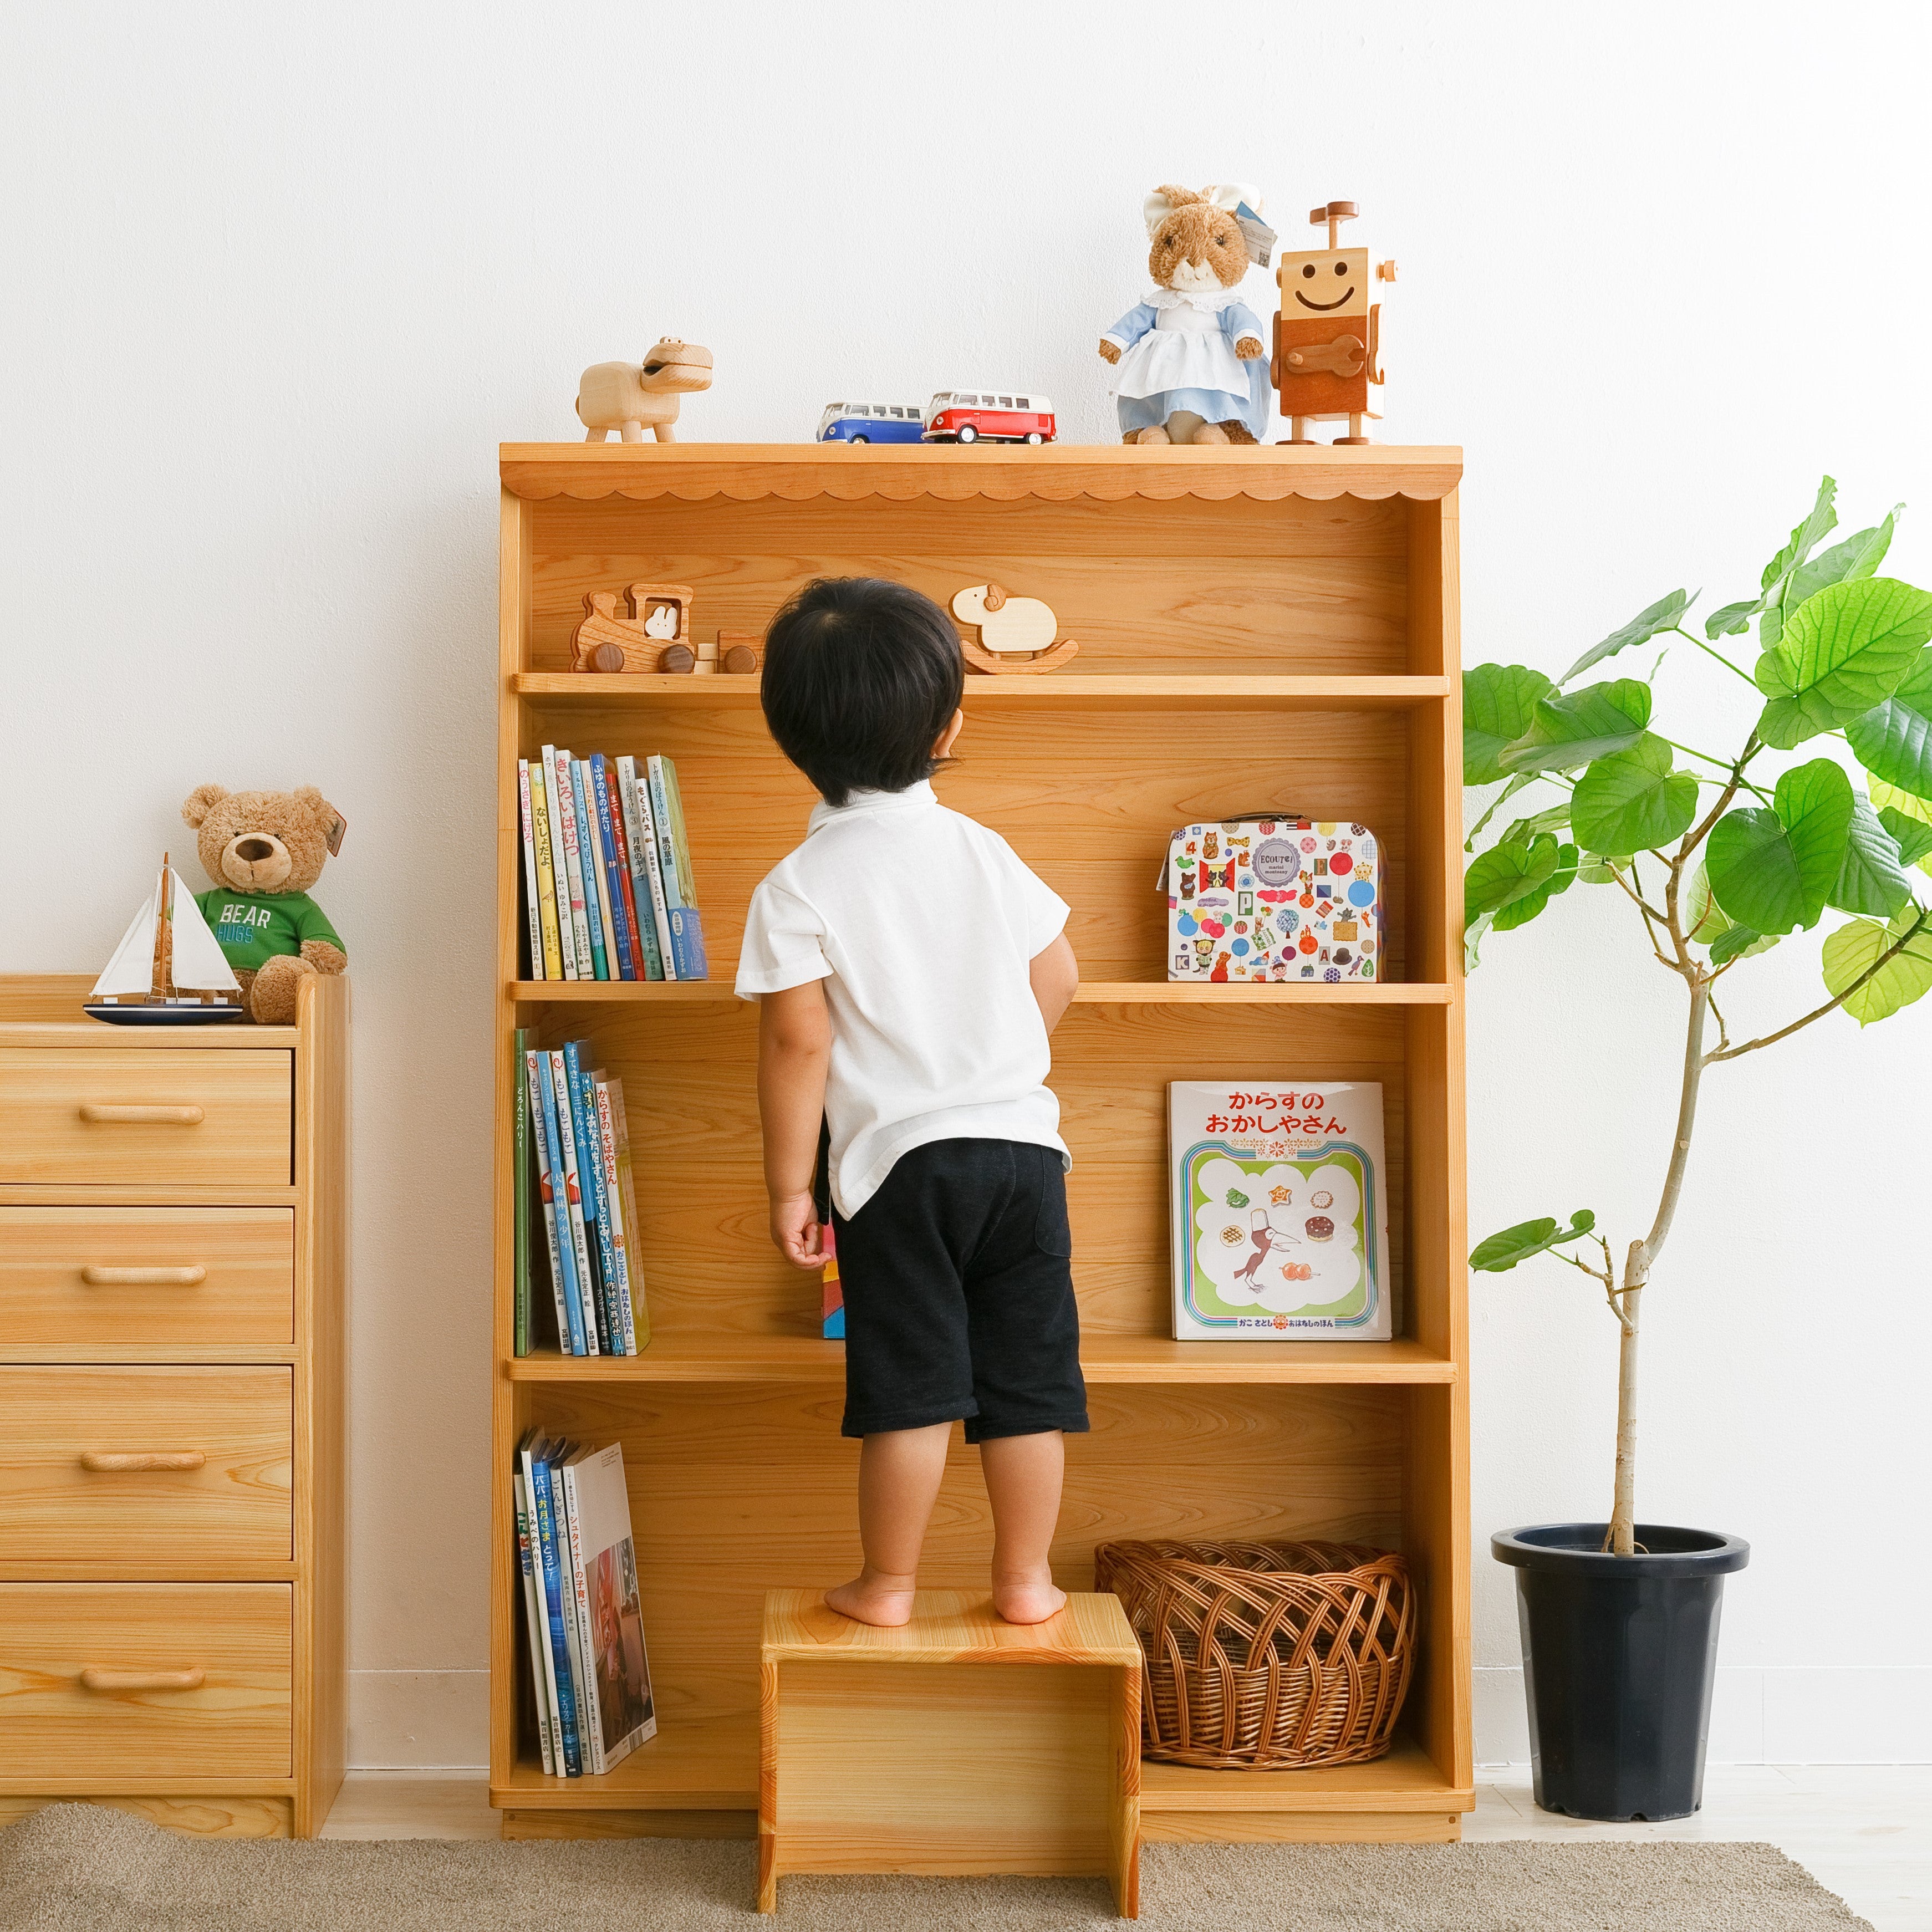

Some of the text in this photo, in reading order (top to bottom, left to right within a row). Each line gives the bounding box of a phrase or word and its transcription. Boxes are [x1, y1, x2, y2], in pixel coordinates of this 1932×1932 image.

[557, 758, 579, 855] きいろいばけつ
[594, 765, 610, 832] ふゆのものがたり
[624, 764, 635, 815] トガリ山のぼうけん
[638, 786, 651, 831] もぐらバス
[653, 764, 664, 815] トガリ山のぼうけん
[537, 807, 550, 869] ないしょだよ。
[633, 837, 644, 881] 月夜のキノコ
[662, 837, 673, 866] 風の草原
[1186, 842, 1196, 854] 4
[1317, 859, 1326, 875] E
[219, 904, 271, 929] BEAR
[1240, 893, 1252, 914] P
[217, 923, 254, 944] HUGS
[1177, 957, 1188, 968] K
[1320, 949, 1329, 961] A
[531, 1078, 541, 1100] もこ
[557, 1078, 566, 1100] もこ
[568, 1048, 580, 1090] すてきな
[1228, 1091, 1324, 1110] からすの
[534, 1107, 548, 1154] もこもこ
[560, 1108, 573, 1154] もこもこ
[598, 1089, 617, 1185] からすの そばやさん
[1205, 1114, 1347, 1134] おかしやさん
[554, 1173, 570, 1249] 大森林の少年
[549, 1220, 558, 1252] 谷川俊太郎
[575, 1221, 585, 1253] 谷川俊太郎
[554, 1269, 563, 1295] 元永定正
[581, 1270, 590, 1296] 元永定正
[616, 1250, 626, 1285] かこさとし
[621, 1288, 633, 1334] おはなしのほん
[552, 1480, 566, 1539] ごんぎつね
[518, 1512, 532, 1576] こんとあき
[529, 1510, 539, 1569] うみべのハリー
[569, 1516, 586, 1608] シュタイナーの子育て
